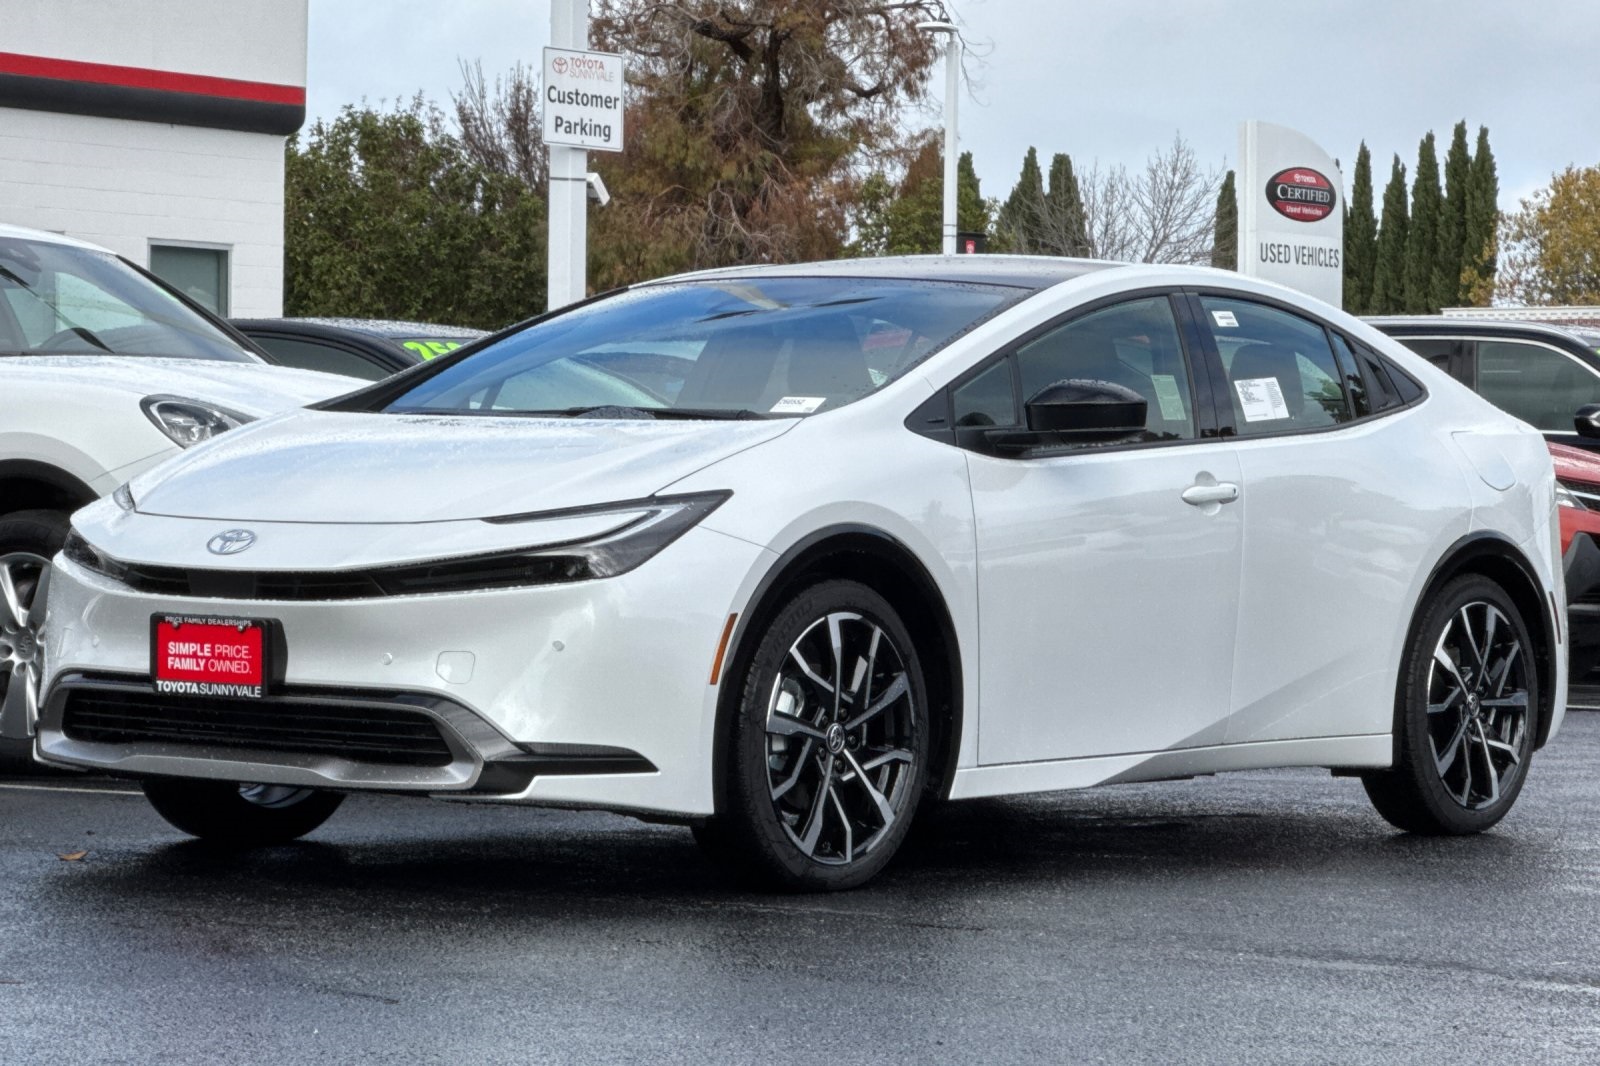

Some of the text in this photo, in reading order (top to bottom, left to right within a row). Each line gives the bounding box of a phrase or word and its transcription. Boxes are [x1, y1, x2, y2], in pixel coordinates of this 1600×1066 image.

[569, 57, 605, 71] TOYOTA
[569, 68, 614, 82] SUNNYVALE
[547, 85, 620, 110] Customer
[554, 115, 611, 143] Parking
[1277, 184, 1330, 203] CERTIFIED
[1286, 205, 1322, 216] Used Vehicles
[1260, 242, 1340, 268] USED VEHICLES
[165, 616, 252, 627] PRICE FAMILY DEALERSHIPS
[168, 641, 252, 659] SIMPLE PRICE.
[167, 656, 252, 674] FAMILY OWNED.
